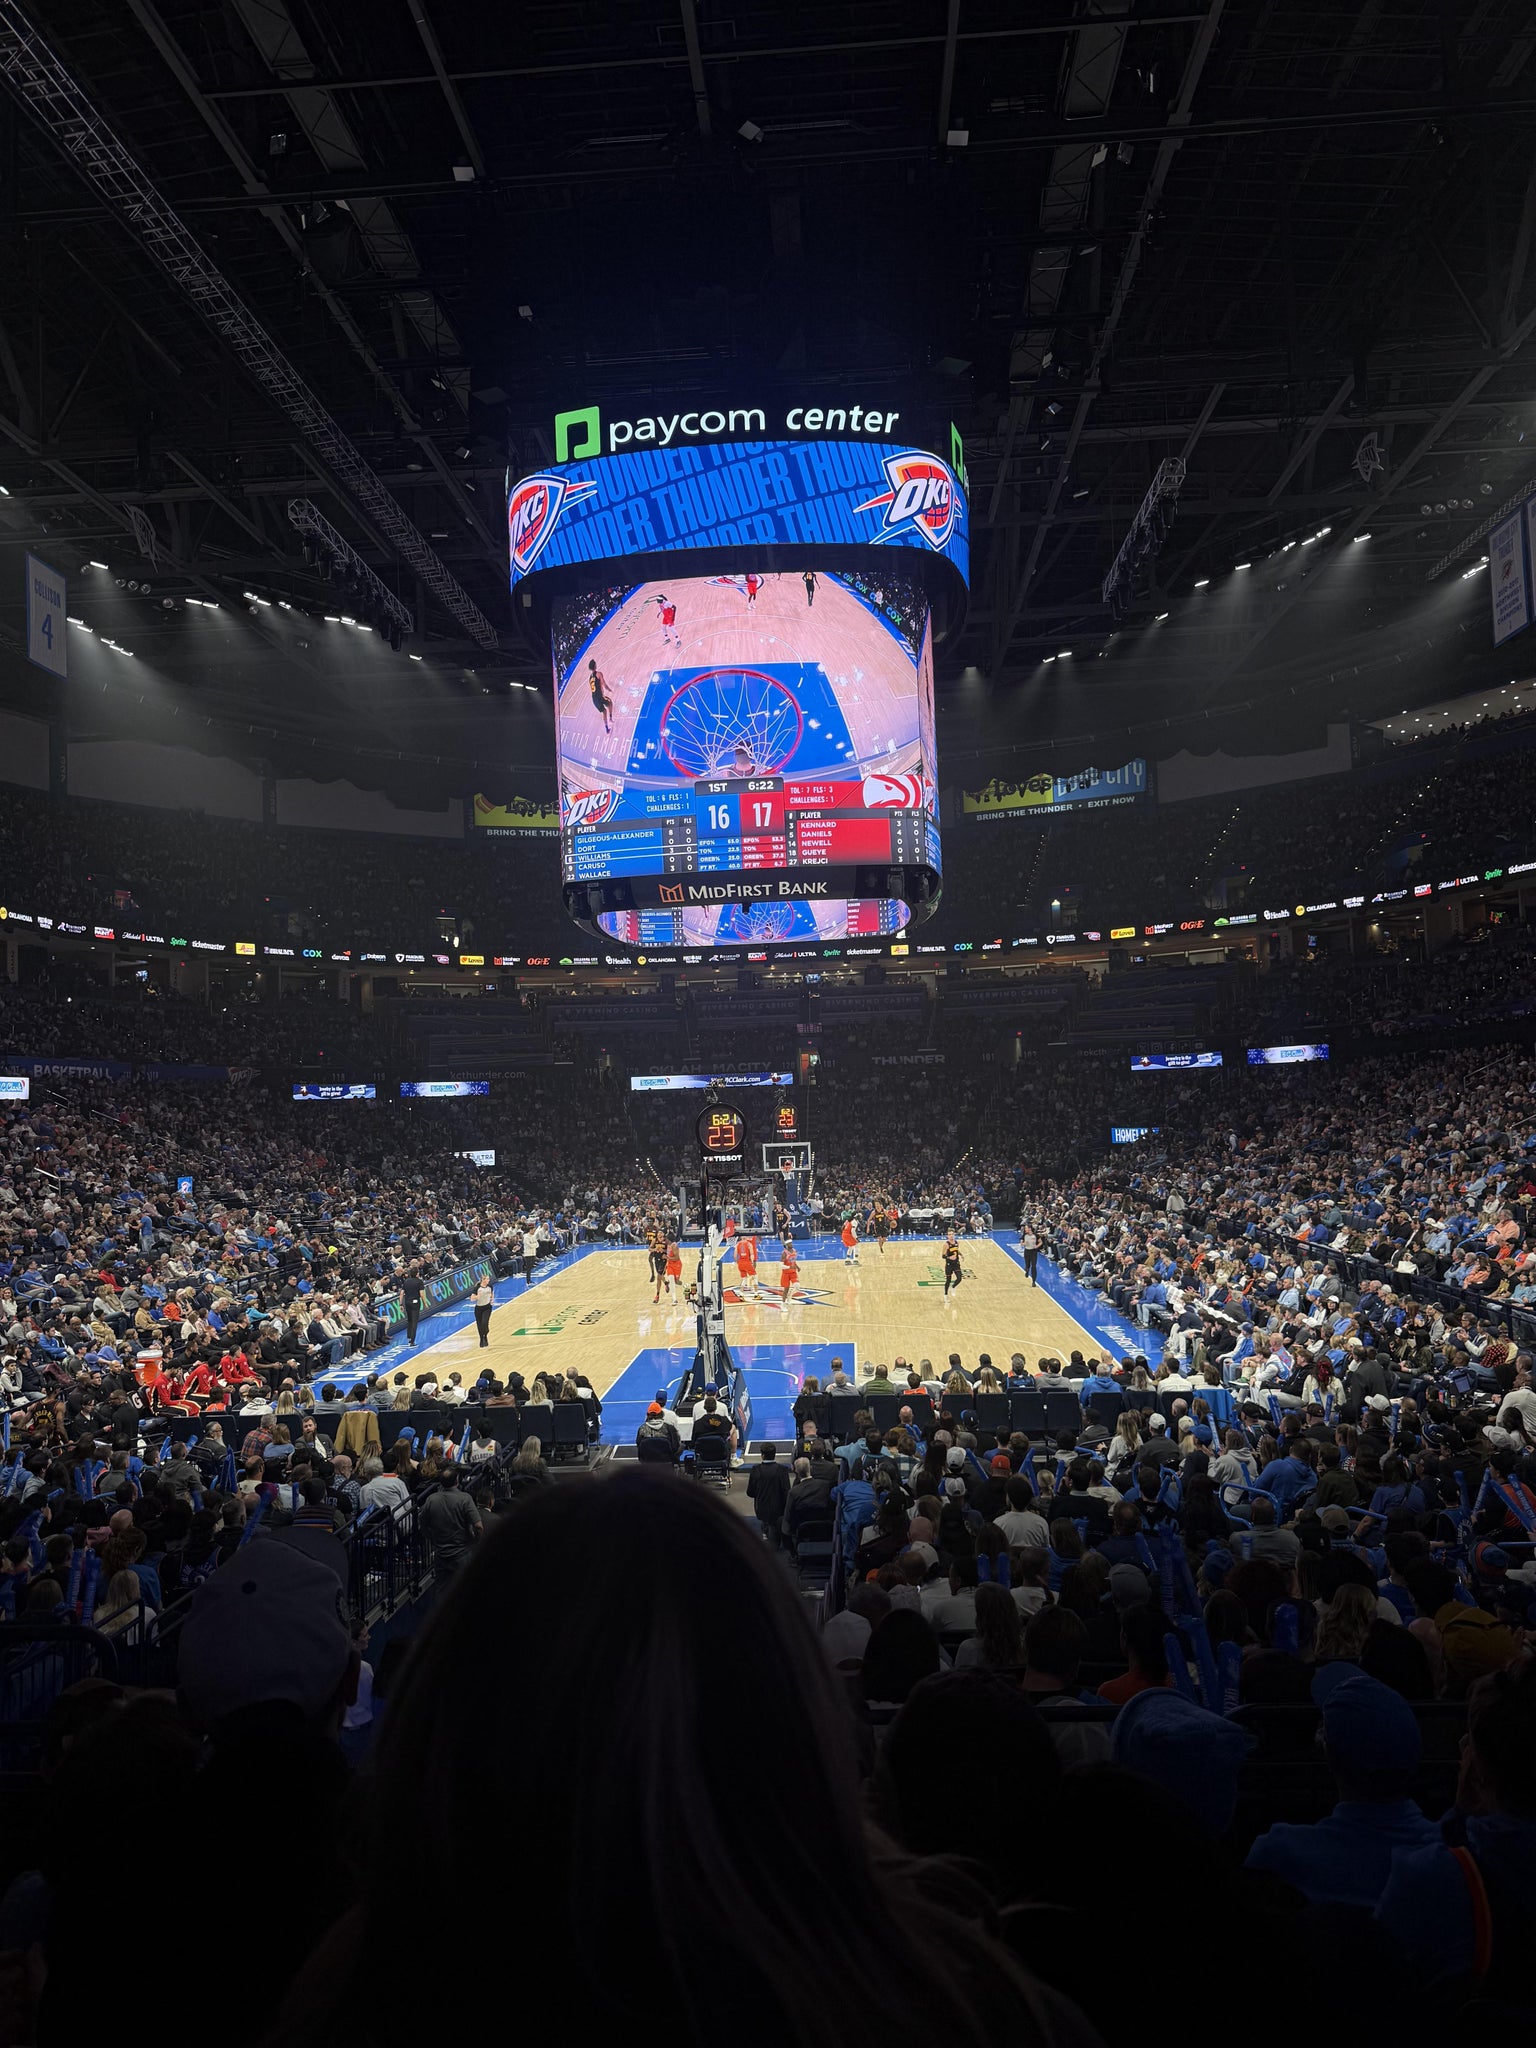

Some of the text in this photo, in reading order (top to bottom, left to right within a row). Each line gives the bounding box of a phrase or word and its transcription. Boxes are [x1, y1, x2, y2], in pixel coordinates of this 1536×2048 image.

[610, 404, 900, 452] paycom center
[650, 452, 798, 540] THUNDER
[888, 477, 949, 523] OKC
[855, 581, 868, 594] COX
[885, 606, 902, 625] COX
[41, 614, 53, 650] 4
[1105, 760, 1143, 786] CITY
[708, 780, 774, 792] 1ST 6:22
[566, 791, 609, 827] OKC
[752, 802, 772, 827] 17
[976, 796, 1135, 821] BRING THE THUNDER EXIT NOW
[708, 804, 730, 830] 16
[577, 825, 596, 834] PLAYER
[577, 831, 655, 844] GILGEOUS-ALEXANDER
[578, 853, 611, 861] WILLIAMS
[578, 862, 606, 870] CARUSO
[1507, 862, 1536, 875] ticketmas
[578, 871, 611, 879] WALLACE
[1460, 875, 1479, 885] ULTRA
[1484, 868, 1503, 880] Sprite
[146, 935, 165, 944] ULTRA
[170, 937, 188, 946] Sprite
[192, 940, 226, 951] ticketmaster
[302, 949, 323, 958] COX
[823, 949, 841, 957] Sprite
[954, 943, 973, 951] COX
[613, 957, 632, 965] Health
[871, 1054, 946, 1066] THUNDER
[34, 1064, 113, 1081] BASKETBALL
[450, 1070, 525, 1081] kcthunder.com
[712, 1113, 737, 1126] 6:21
[779, 1115, 794, 1126] 23
[708, 1126, 735, 1147] 23
[474, 1261, 493, 1282] COX
[454, 1269, 474, 1292] COX
[432, 1278, 454, 1302] COX
[378, 1298, 405, 1324] COX
[132, 1392, 144, 1409] G
